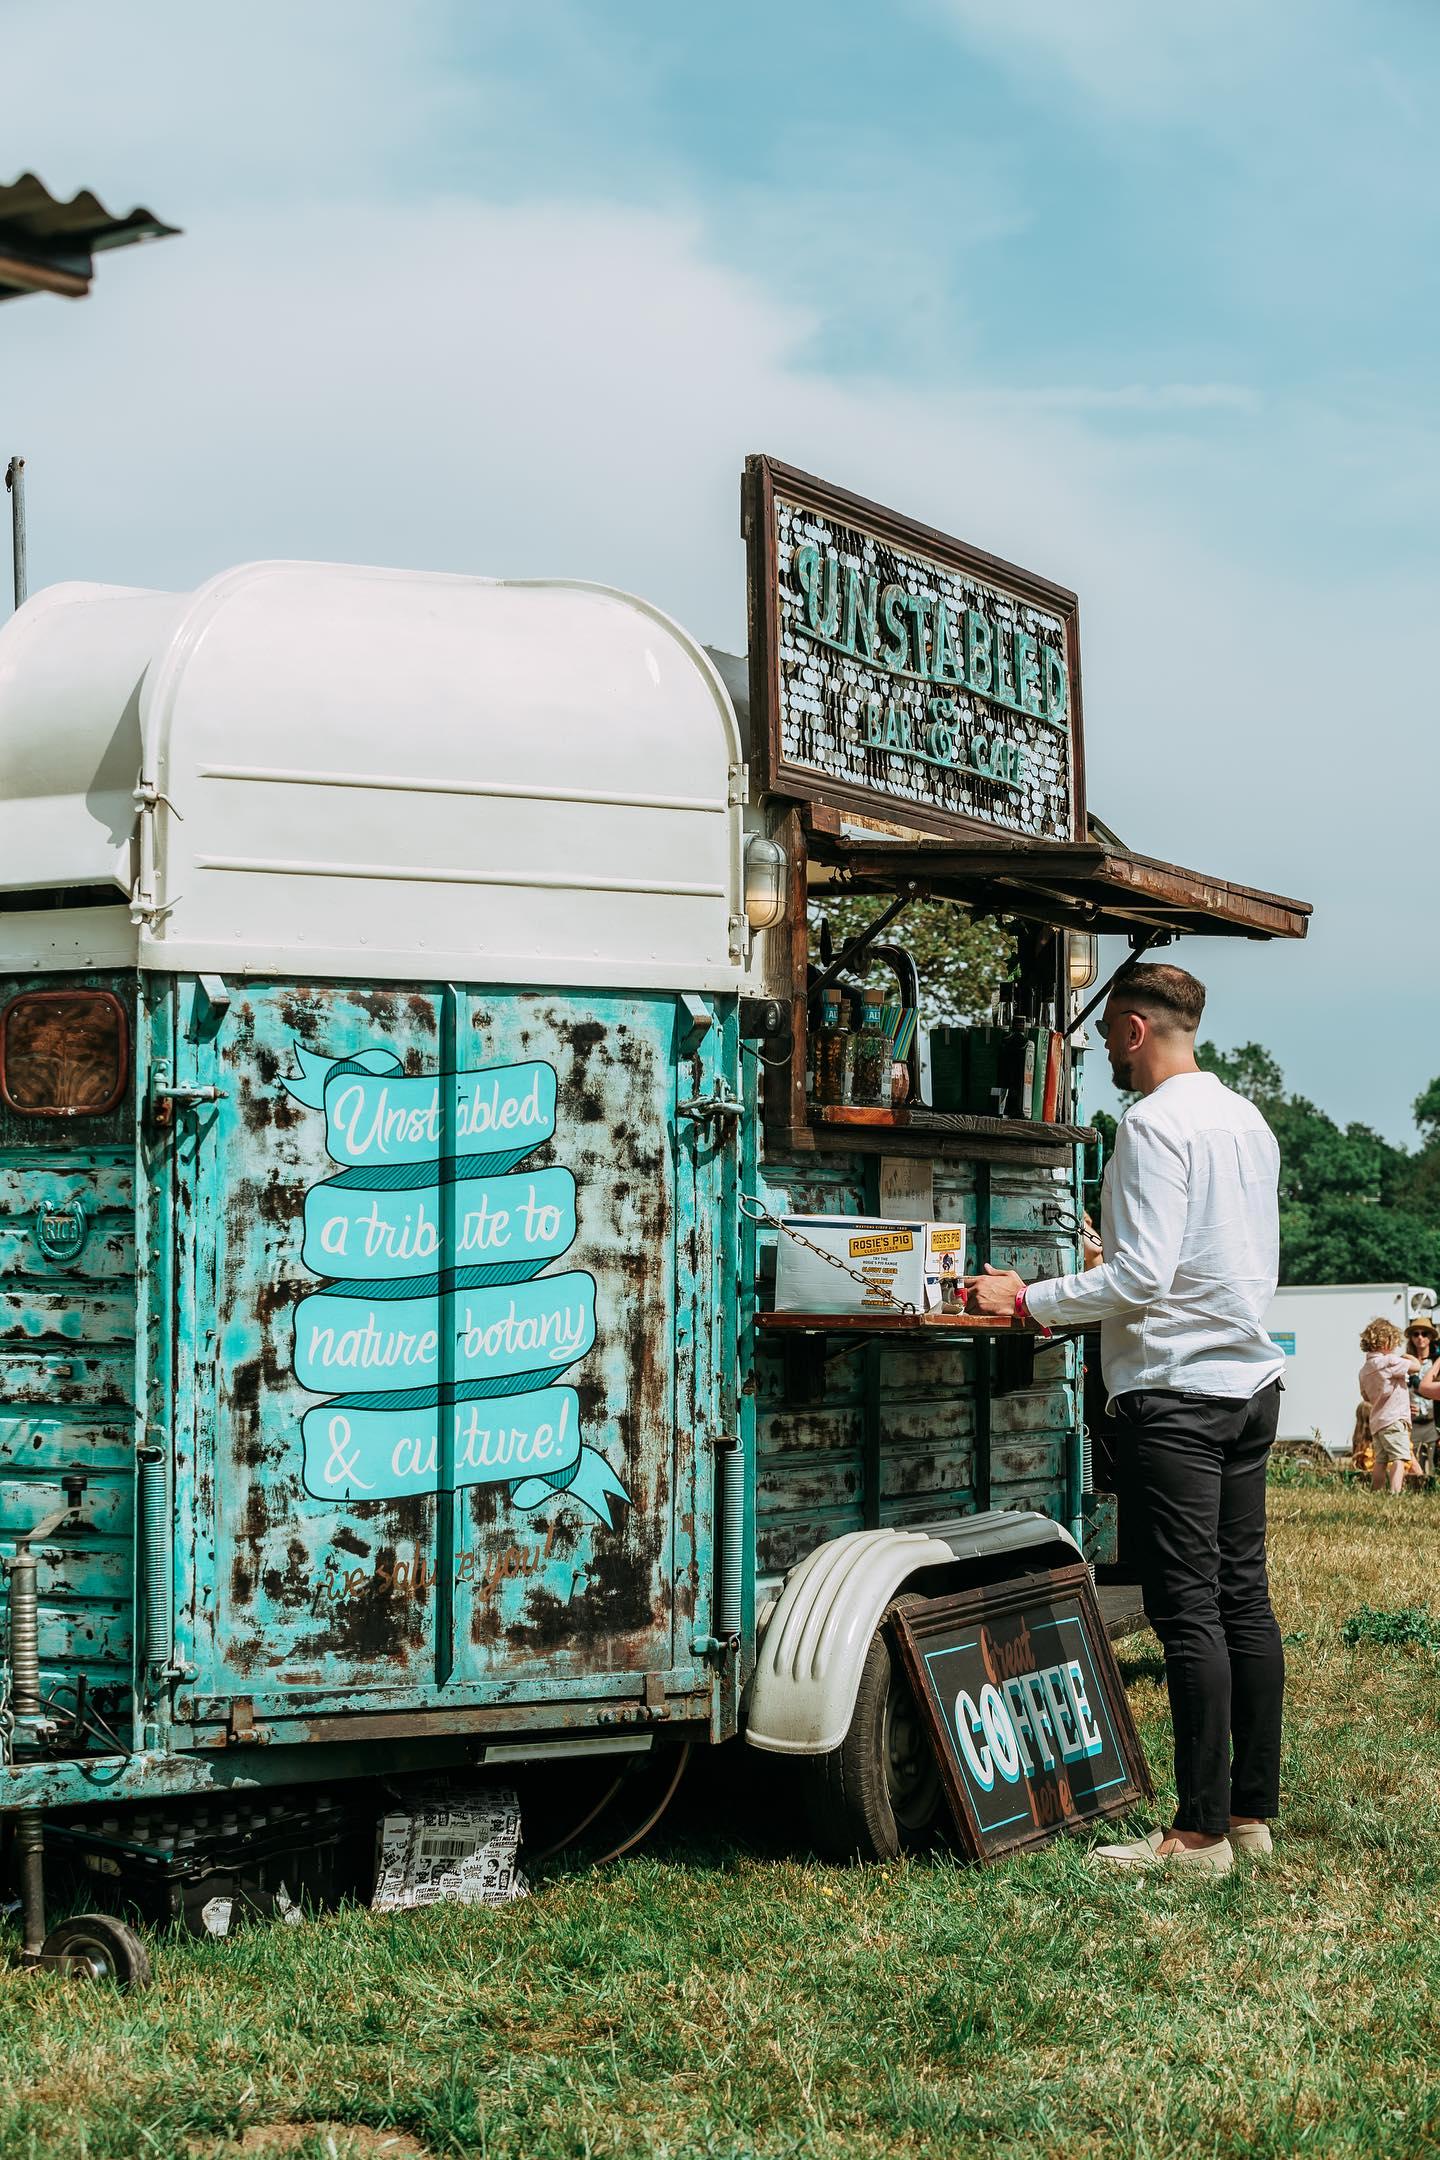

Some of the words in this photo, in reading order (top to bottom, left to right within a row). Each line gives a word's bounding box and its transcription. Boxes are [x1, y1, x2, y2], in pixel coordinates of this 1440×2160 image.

[794, 546, 1067, 722] UNSTABLED
[863, 702, 912, 749] BAR
[927, 697, 960, 762] &
[320, 1215, 347, 1256] a
[516, 1185, 564, 1242] to
[853, 1237, 889, 1250] ROSIE'S
[892, 1235, 910, 1246] PIG
[933, 1232, 950, 1244] ROSIE'S
[951, 1231, 960, 1243] PIG
[308, 1312, 437, 1368] nature
[464, 1300, 586, 1361] botany
[323, 1415, 376, 1490] &
[326, 1567, 370, 1600] we
[377, 1540, 474, 1593] salue
[480, 1522, 554, 1603] you!
[981, 1615, 1036, 1684] Great
[954, 1660, 1102, 1792] COFFEE
